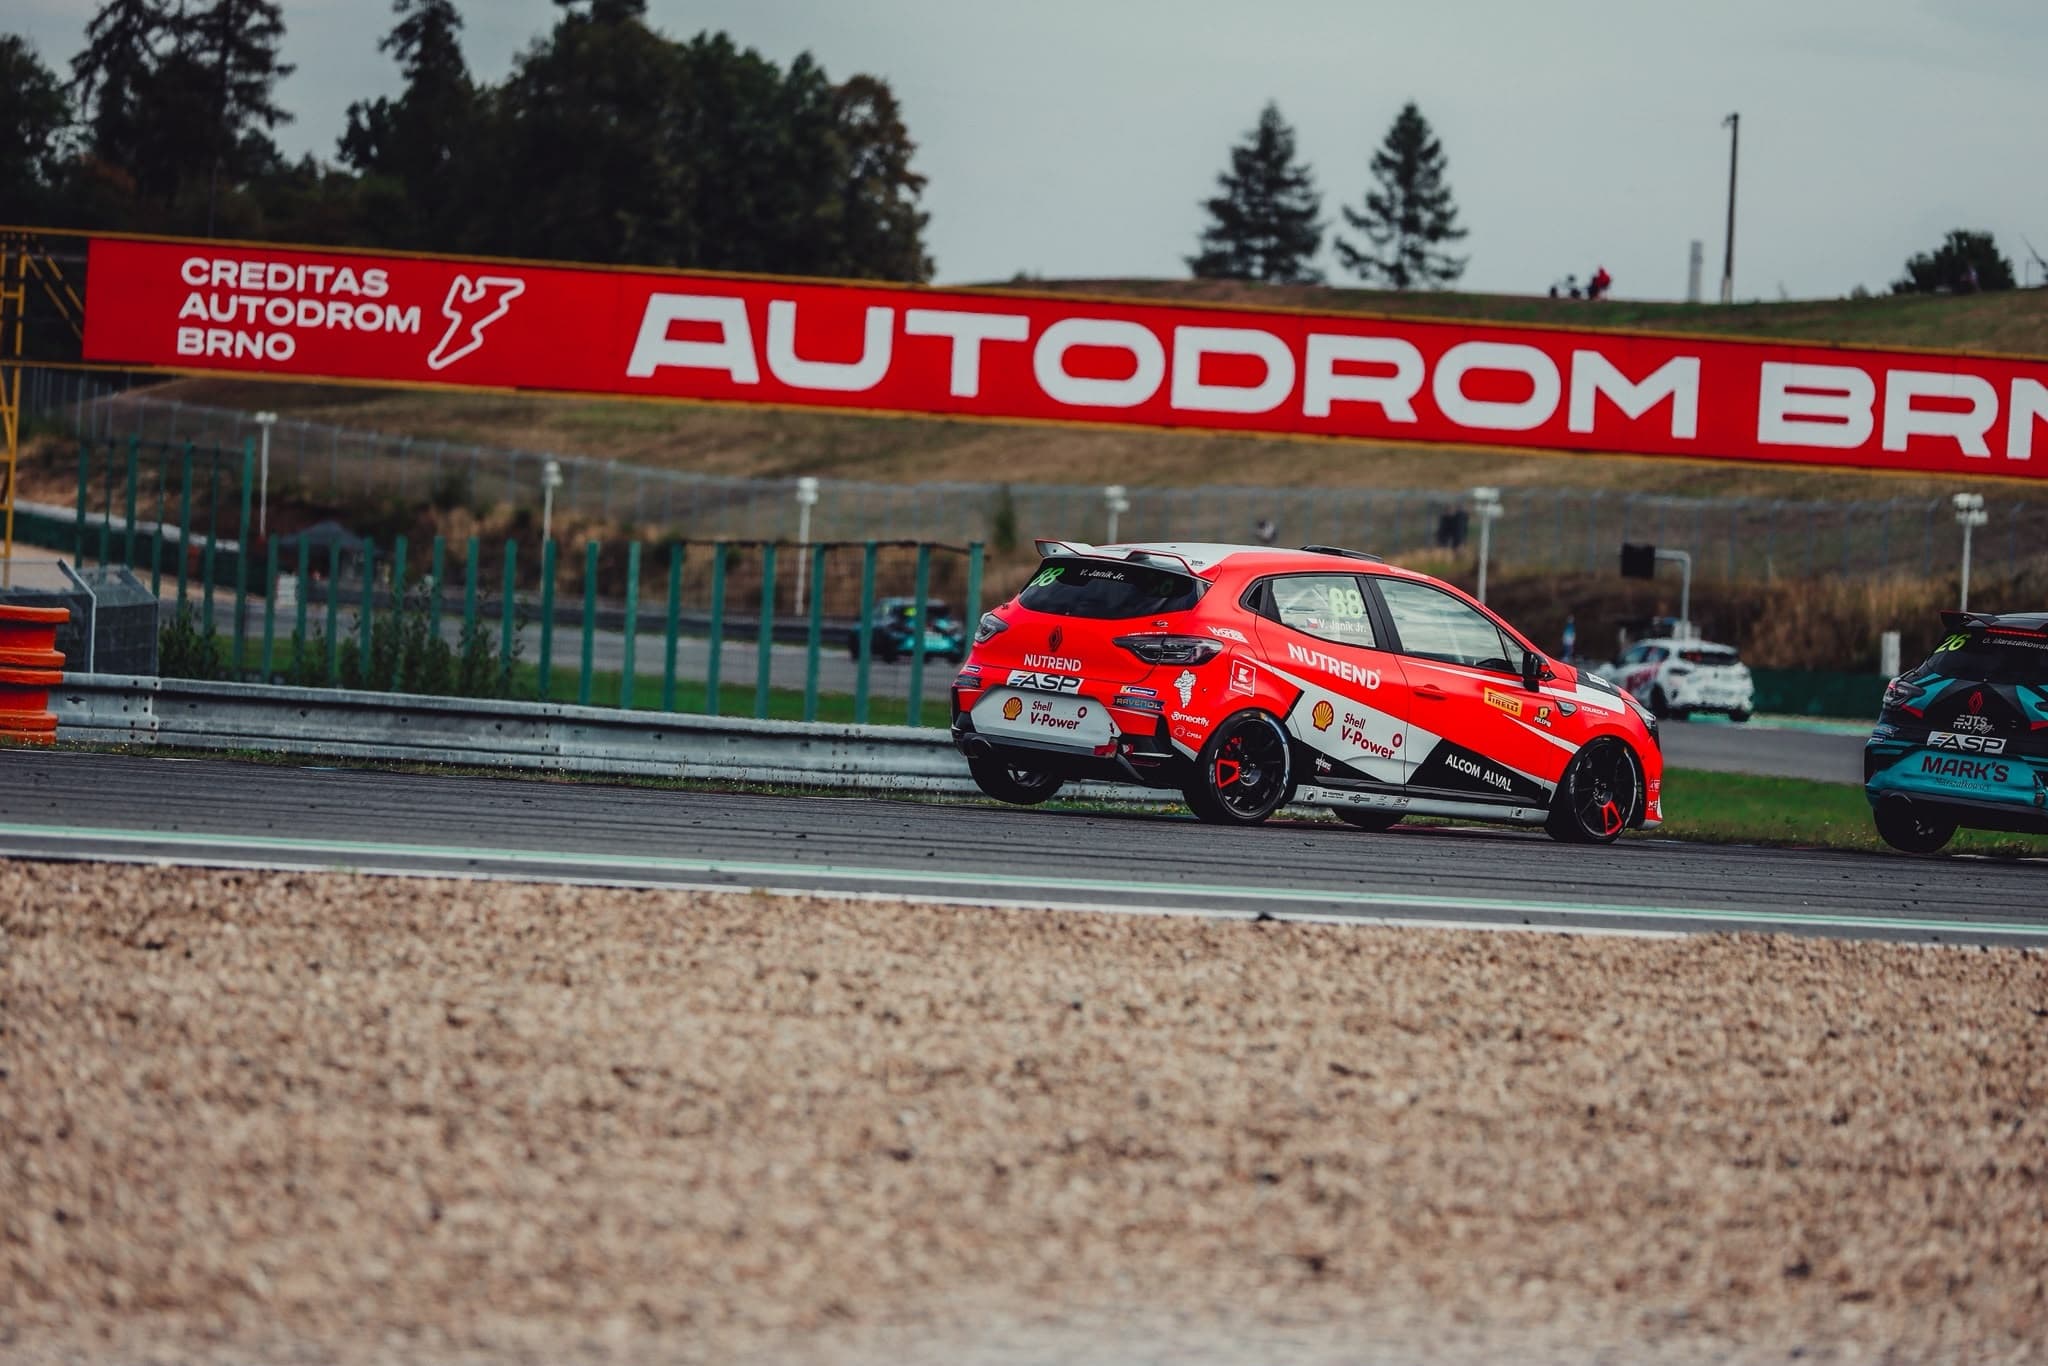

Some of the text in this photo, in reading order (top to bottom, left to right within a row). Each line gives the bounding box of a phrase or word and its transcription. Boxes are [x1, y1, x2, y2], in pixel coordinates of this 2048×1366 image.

[181, 257, 389, 298] CREDITAS
[178, 292, 421, 334] AUTODROM
[177, 326, 296, 361] BRNO
[626, 292, 1700, 440] AUTODROM
[1029, 567, 1065, 587] 88
[1328, 587, 1364, 618] 88
[1934, 633, 1972, 654] 26
[1023, 653, 1082, 672] NUTREND
[1287, 642, 1381, 690] NUTREND
[1031, 700, 1053, 712] Shell
[1115, 697, 1161, 710] RAVENOL
[1487, 691, 1520, 713] PIRELLI
[1030, 711, 1080, 730] V-Power
[1343, 712, 1366, 729] Shell
[1341, 725, 1395, 760] V-Power
[1445, 753, 1513, 792] ALCOM ALVAL
[1921, 755, 2010, 783] MARK'S
